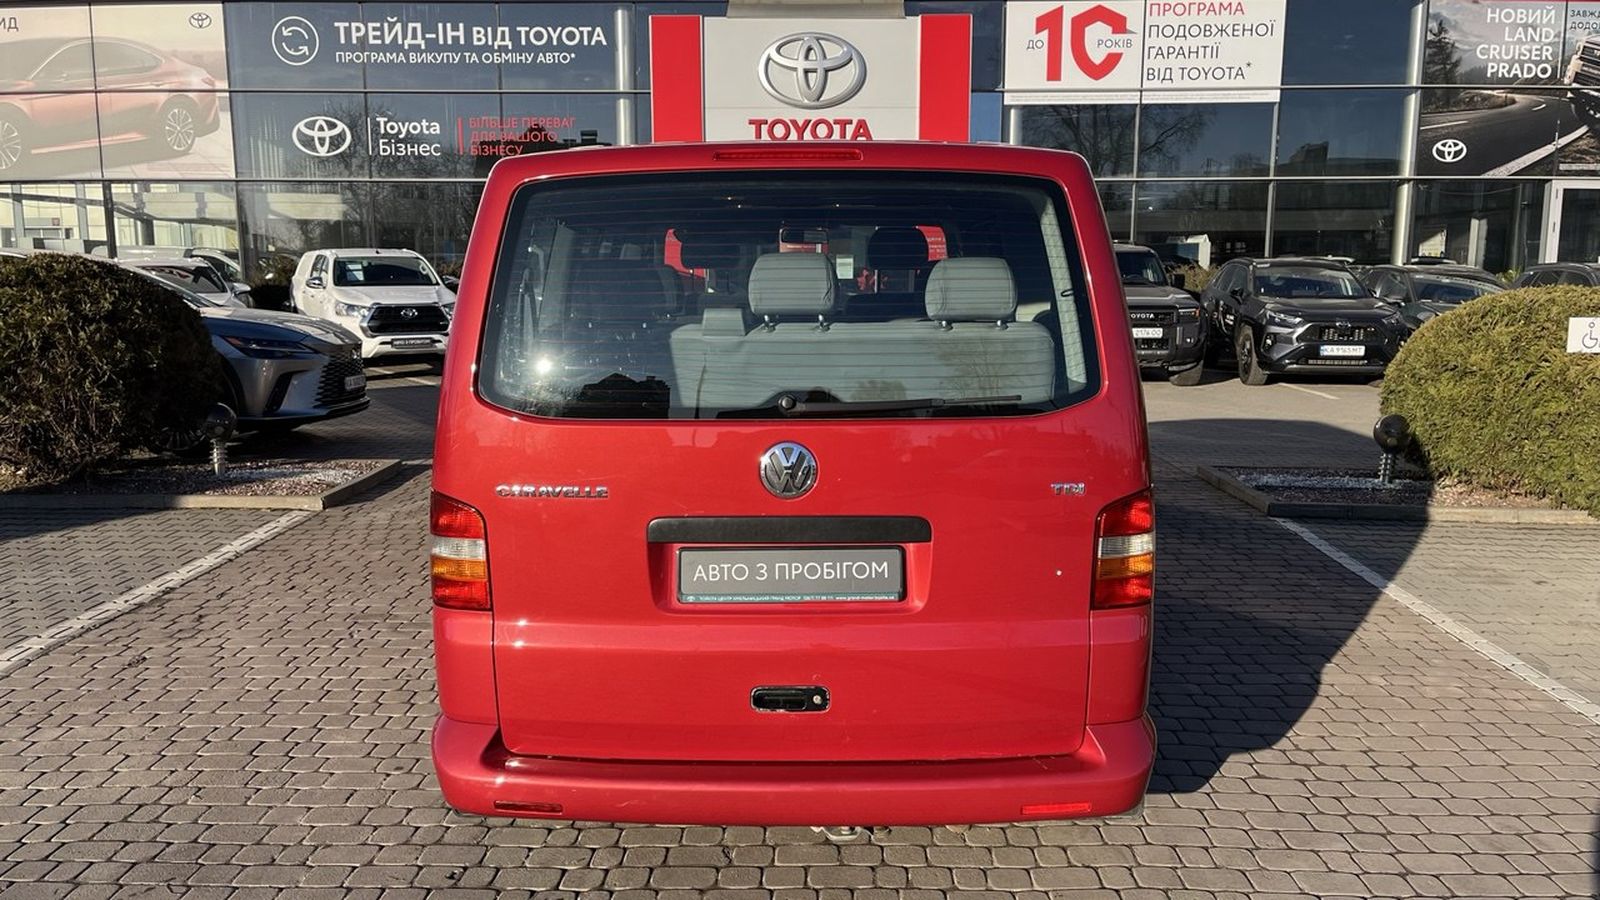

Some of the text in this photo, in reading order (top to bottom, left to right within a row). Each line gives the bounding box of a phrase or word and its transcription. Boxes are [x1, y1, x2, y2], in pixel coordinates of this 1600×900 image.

[1149, 2, 1245, 17] ПРОГРАМА
[1487, 5, 1556, 24] НОВИЙ
[334, 17, 607, 50] ТРЕЙД-ІН ВІД TOYOTA
[1148, 20, 1275, 41] ПОДОВЖЕНОЇ
[1504, 26, 1555, 42] LAND
[1569, 21, 1600, 31] ДОДО
[1026, 39, 1044, 50] ДО
[1096, 38, 1133, 49] РОКІВ
[1147, 42, 1222, 60] ГАРАНТІЇ
[1476, 44, 1553, 60] CRUISER
[335, 51, 406, 64] ПРОГРАМА
[409, 52, 461, 64] ВИКУПУ
[463, 52, 480, 64] ТА
[482, 52, 534, 64] ОБМІНУ
[1146, 67, 1174, 84] ВІД
[1486, 62, 1552, 78] PRADO
[376, 117, 441, 138] Toyota
[469, 117, 576, 128] БІЛЬШЕ ПЕРЕВАГ
[748, 118, 874, 141] TOYOTA
[470, 131, 558, 144] ДЛЯ ВАШОГО
[379, 139, 441, 157] Бізнес
[470, 145, 524, 156] БІЗНЕСУ
[495, 484, 609, 499] CARAVELLE
[693, 563, 749, 582] АВТО
[775, 561, 888, 581] ПРОБІГОМ
